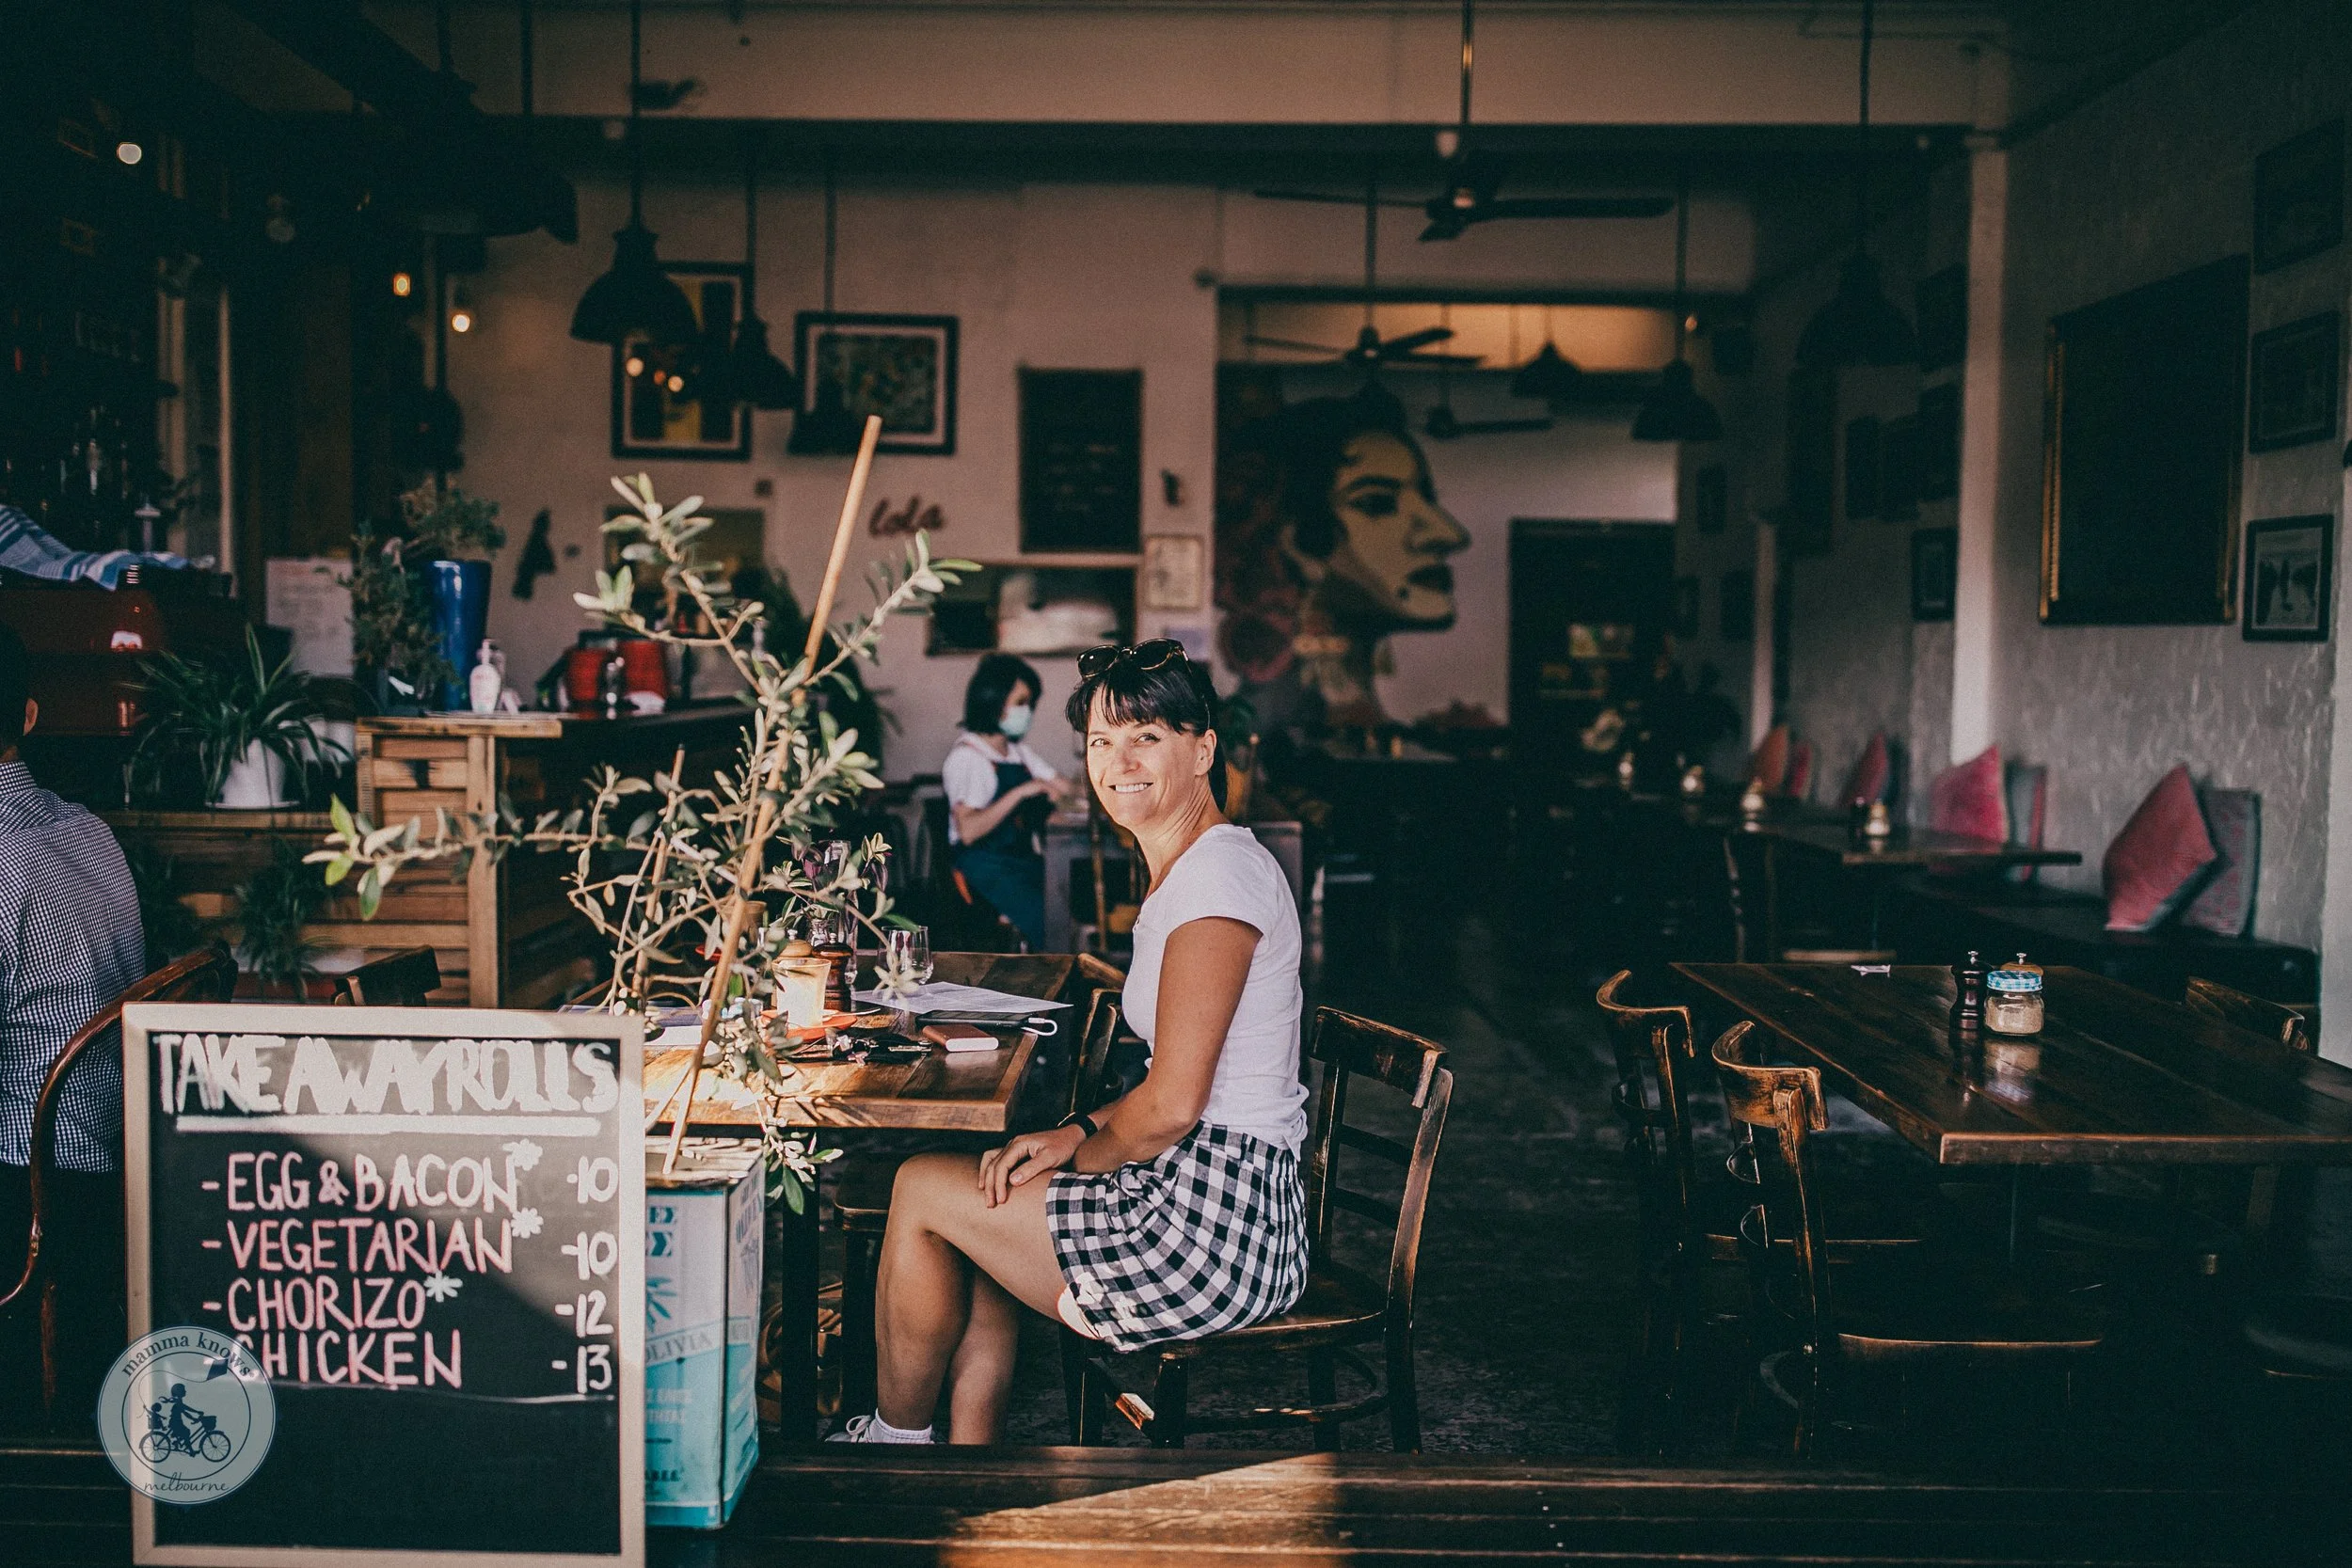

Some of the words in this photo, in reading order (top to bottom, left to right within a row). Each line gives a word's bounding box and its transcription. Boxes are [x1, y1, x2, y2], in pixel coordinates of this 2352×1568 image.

[152, 1034, 285, 1115] TAKE
[446, 1038, 619, 1114] ROLLS
[318, 1160, 350, 1206] &
